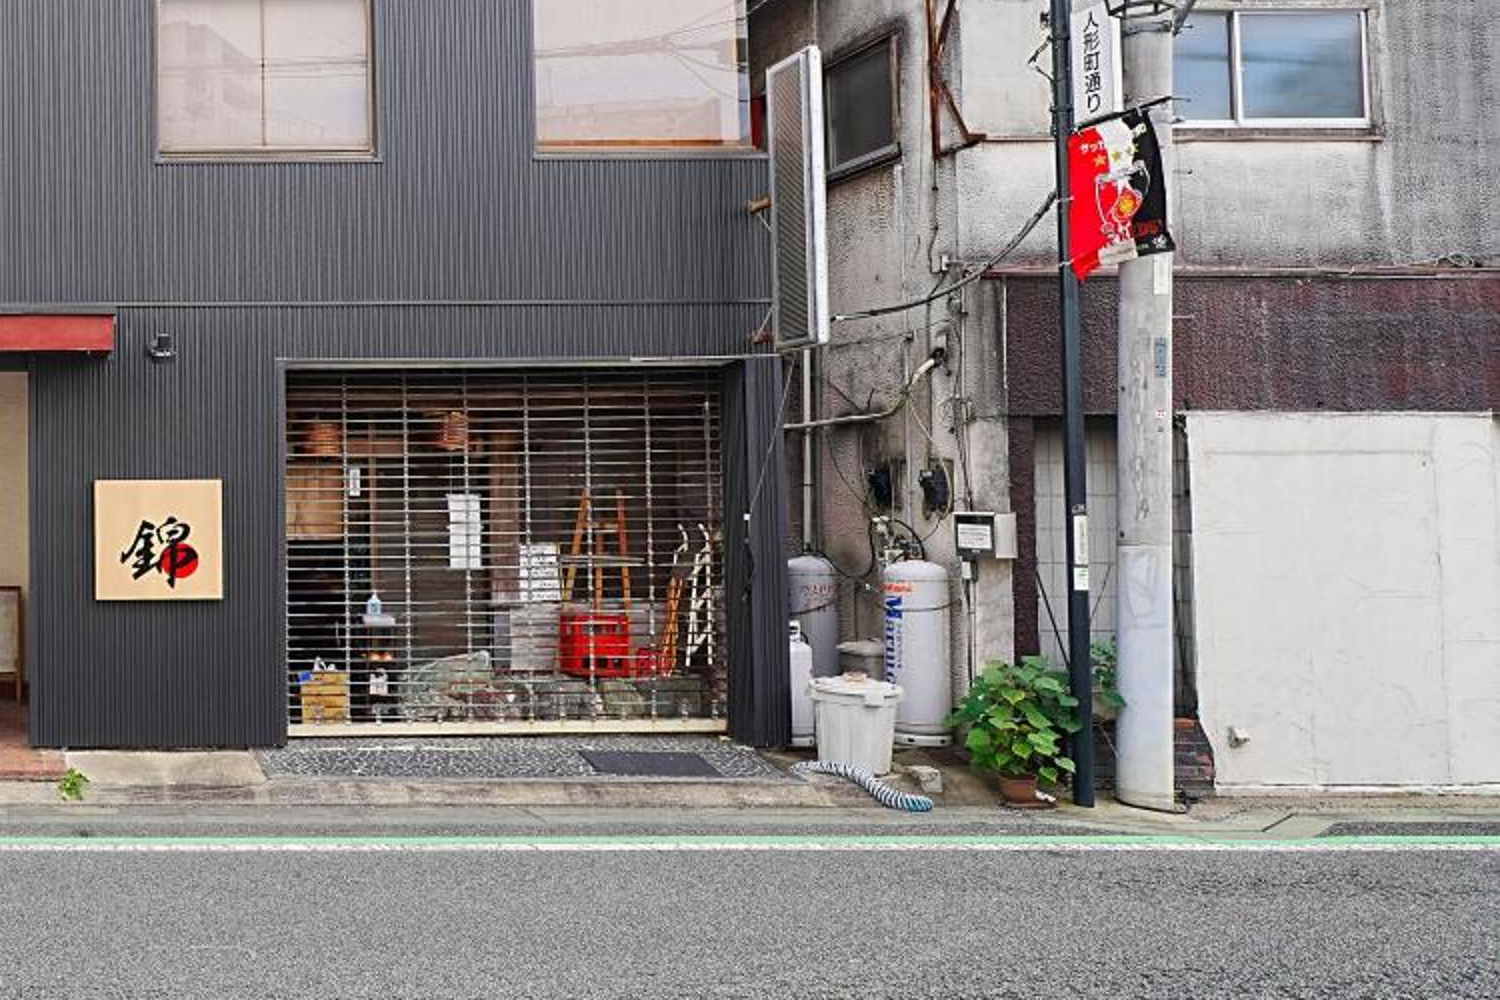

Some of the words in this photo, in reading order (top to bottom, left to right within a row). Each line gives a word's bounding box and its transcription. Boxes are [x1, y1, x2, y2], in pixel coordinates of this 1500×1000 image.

[1083, 11, 1101, 114] 人形町通り
[120, 516, 198, 589] 錦
